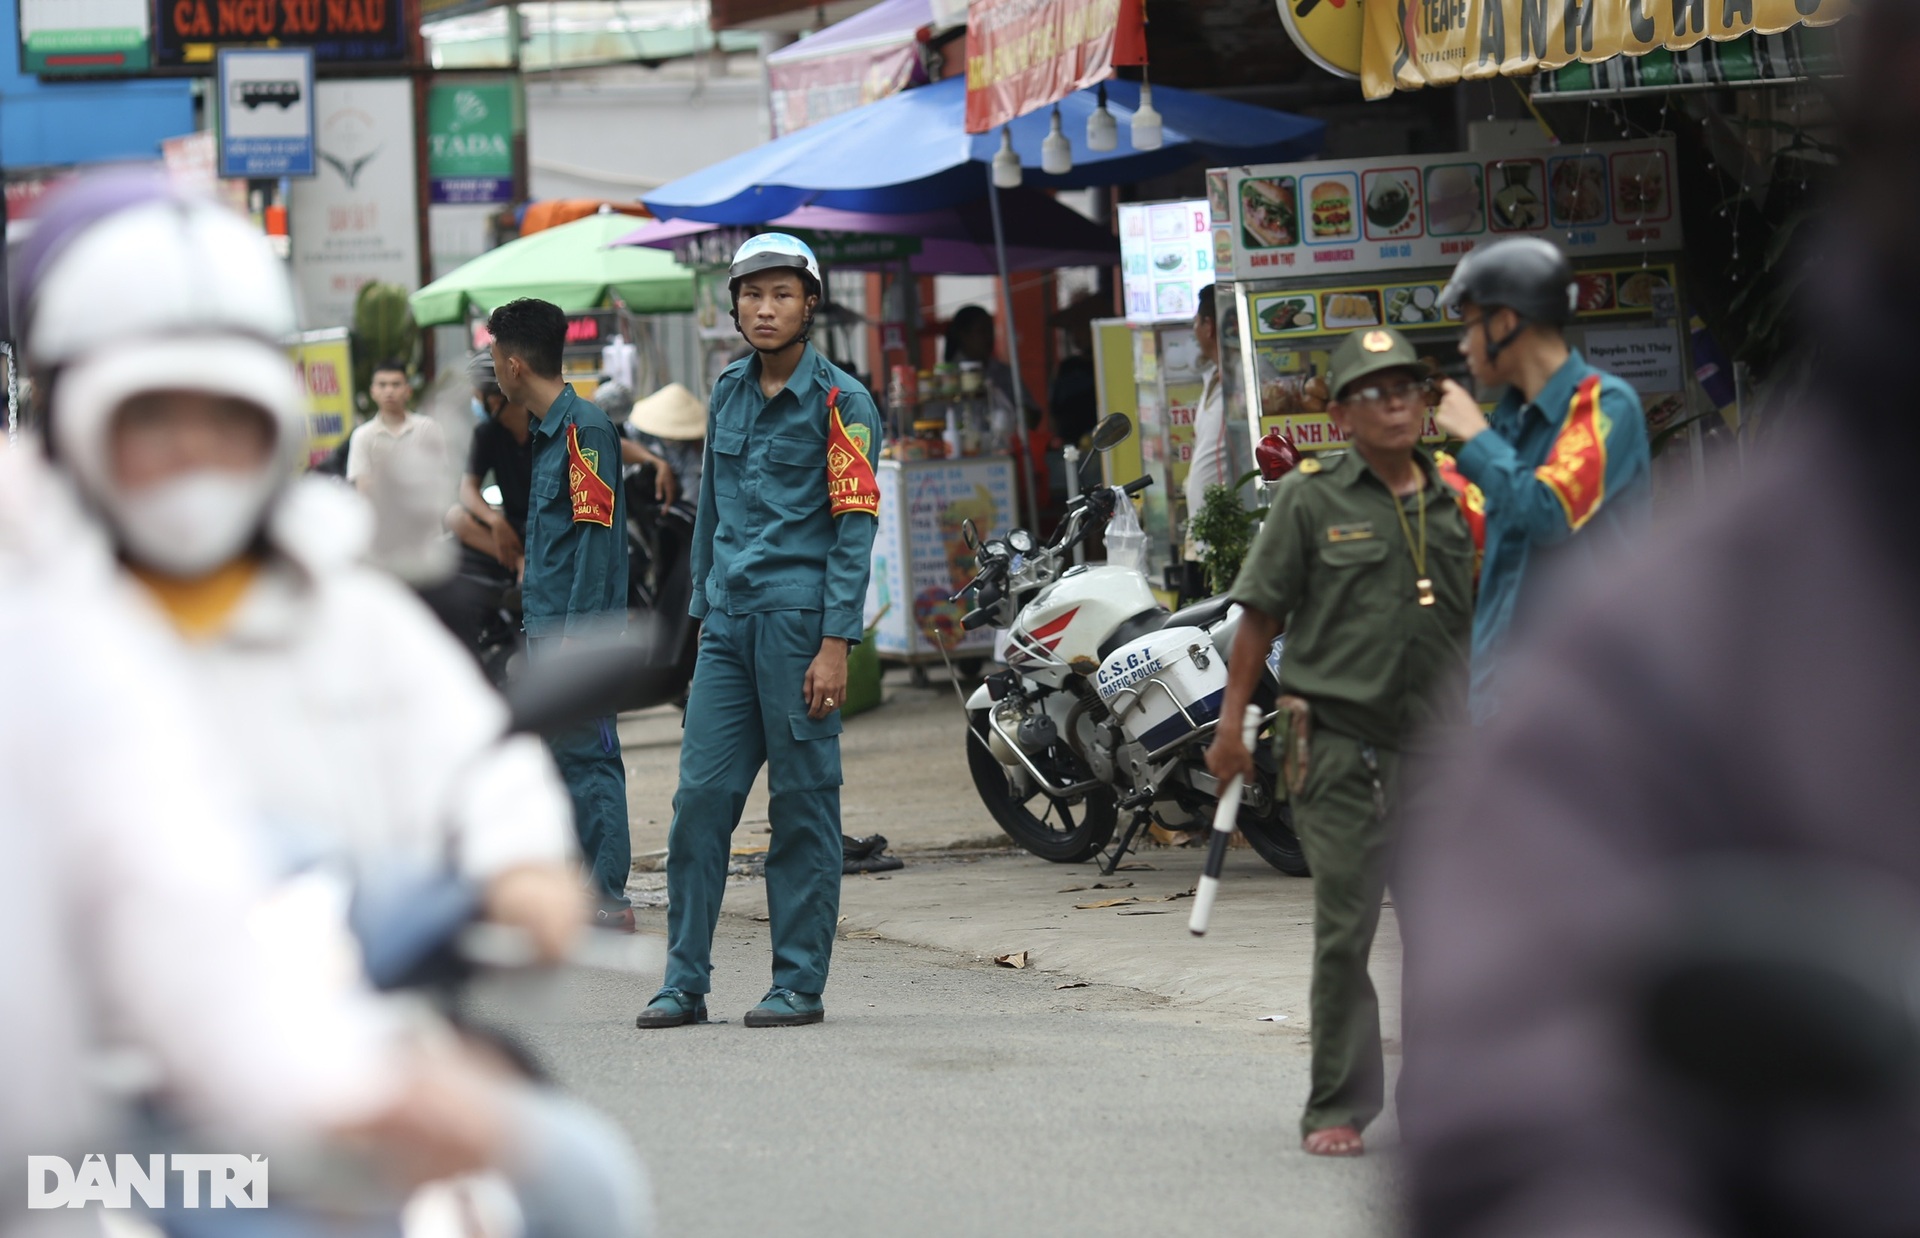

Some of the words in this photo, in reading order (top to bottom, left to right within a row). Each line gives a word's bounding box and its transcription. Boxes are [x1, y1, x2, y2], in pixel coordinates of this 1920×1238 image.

[427, 133, 507, 157] TADA
[1314, 249, 1354, 263] HAMBURGER
[1100, 674, 1132, 700] TRAFFIC
[1132, 658, 1163, 683] POLICE
